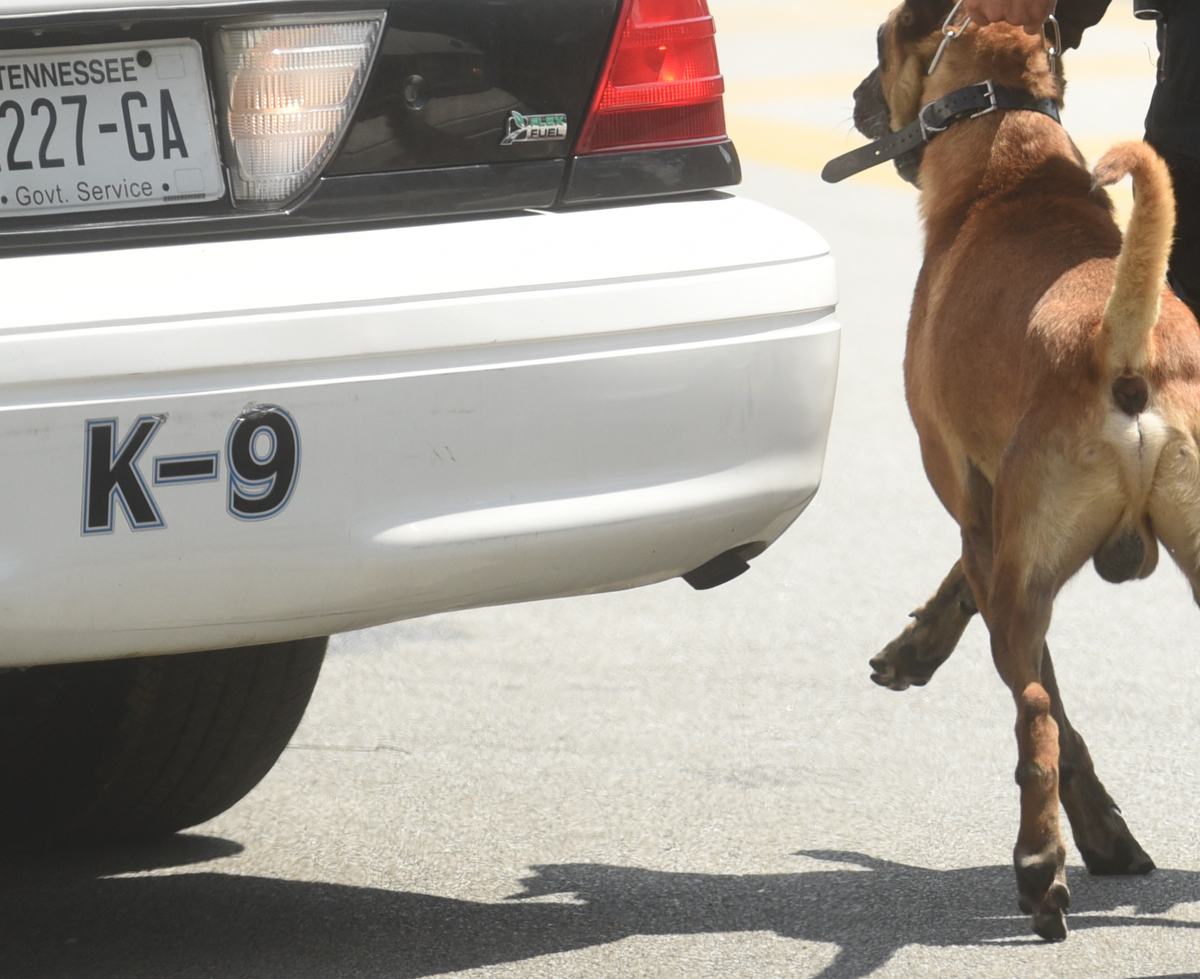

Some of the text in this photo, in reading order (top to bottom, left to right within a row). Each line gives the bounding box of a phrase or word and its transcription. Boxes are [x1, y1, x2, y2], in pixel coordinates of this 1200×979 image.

[530, 128, 564, 138] FUEL
[15, 186, 69, 206] Govt.
[76, 178, 153, 201] Service
[81, 404, 301, 534] K-9
